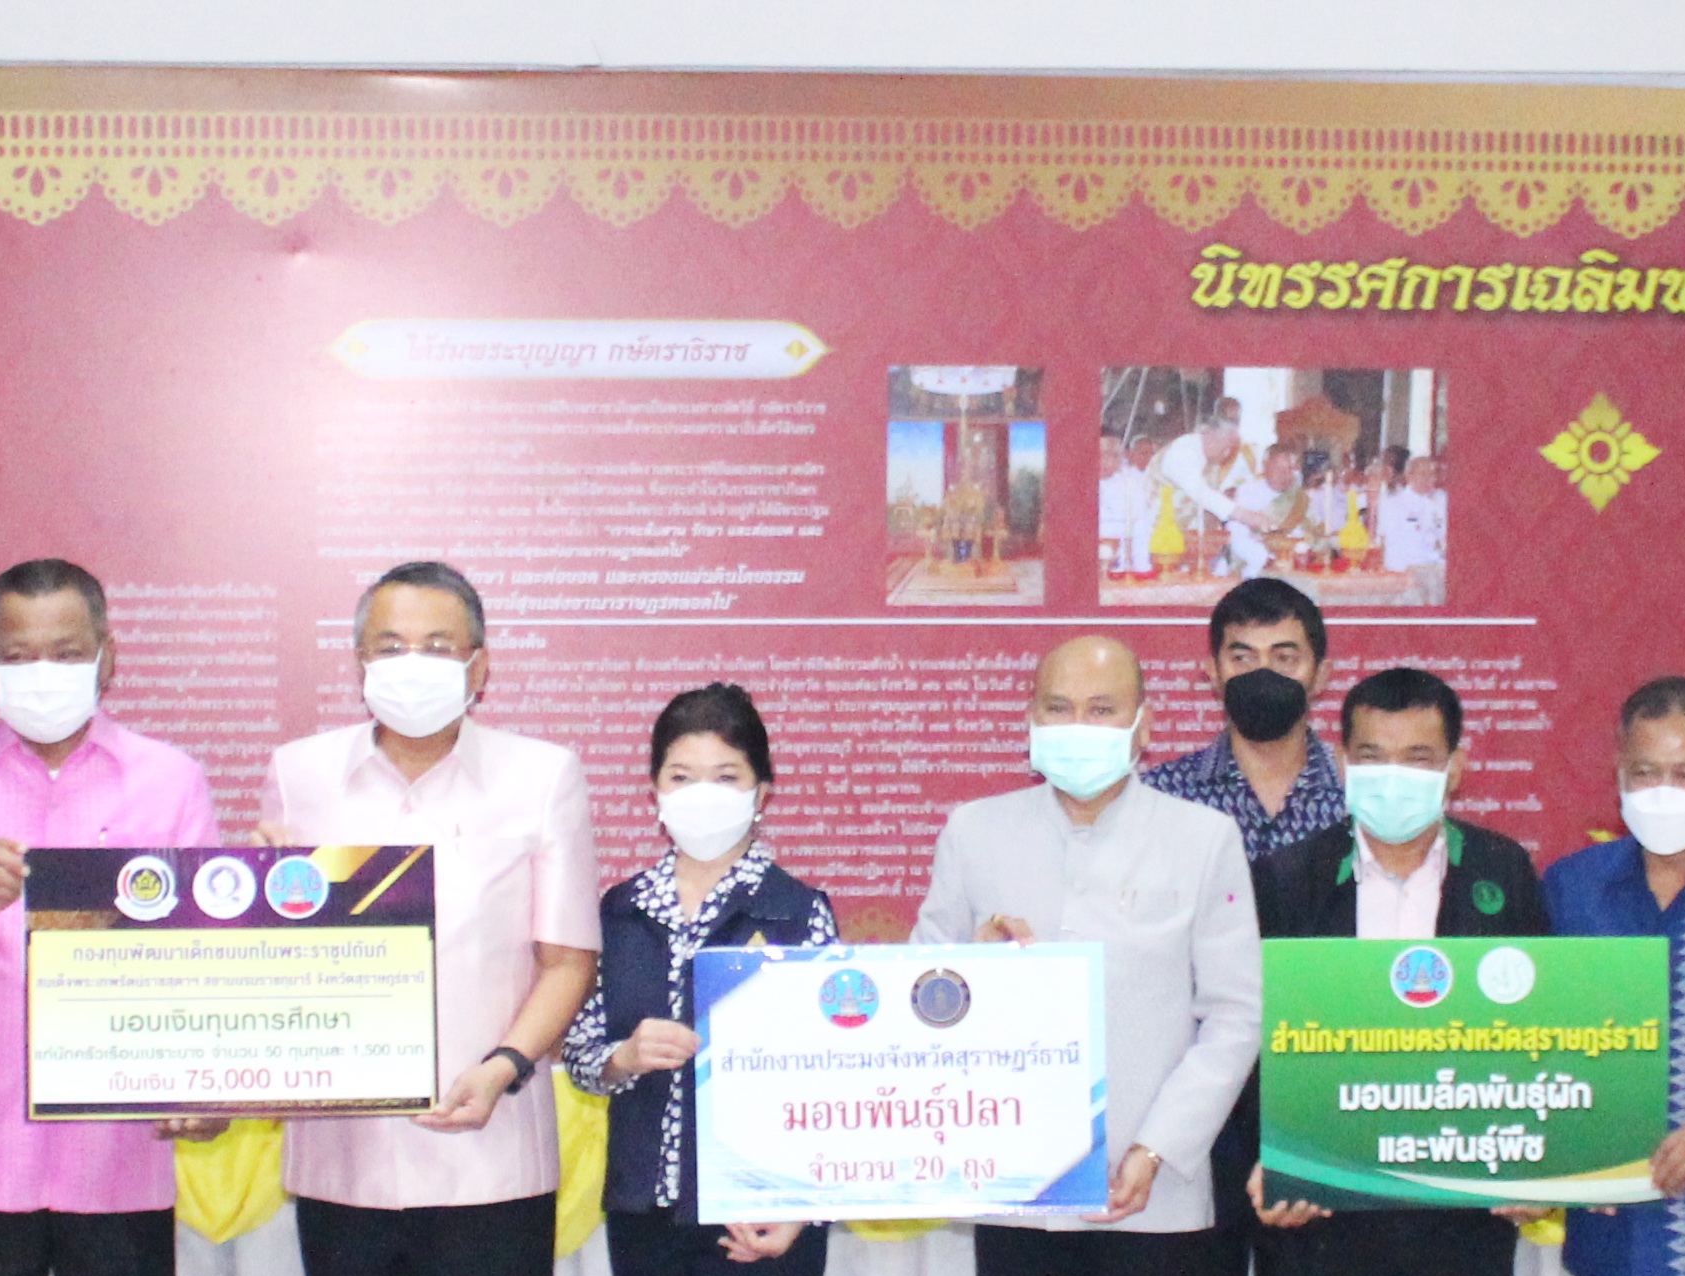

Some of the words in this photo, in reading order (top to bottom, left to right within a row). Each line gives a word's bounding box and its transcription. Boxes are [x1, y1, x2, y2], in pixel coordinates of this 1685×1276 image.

[109, 1005, 351, 1038] มอบเงินทุนการศึกษา
[1271, 1020, 1659, 1062] สำนักงานเกษตรจังหวัดสุราษฎร์ธานี
[211, 1042, 259, 1060] จำนวน
[264, 1044, 283, 1059] 50
[352, 1042, 392, 1059] 1,500
[396, 1043, 425, 1058] บาท
[720, 1040, 1081, 1079] สำนักงานประมงจังหวัดสุราษฎร์ธานี
[108, 1068, 176, 1092] เป็นเงิน
[185, 1067, 272, 1092] 75,000
[284, 1069, 333, 1089] บาท
[1338, 1071, 1593, 1120] มอบเมล็ดพันธุ์ผัก
[782, 1080, 1023, 1144] มอบพันธุ์ปลา
[1377, 1122, 1546, 1176] และพันธุ์พืช
[808, 1158, 896, 1185] จำนวน
[914, 1157, 946, 1181] 20
[963, 1158, 996, 1189] ถุง
